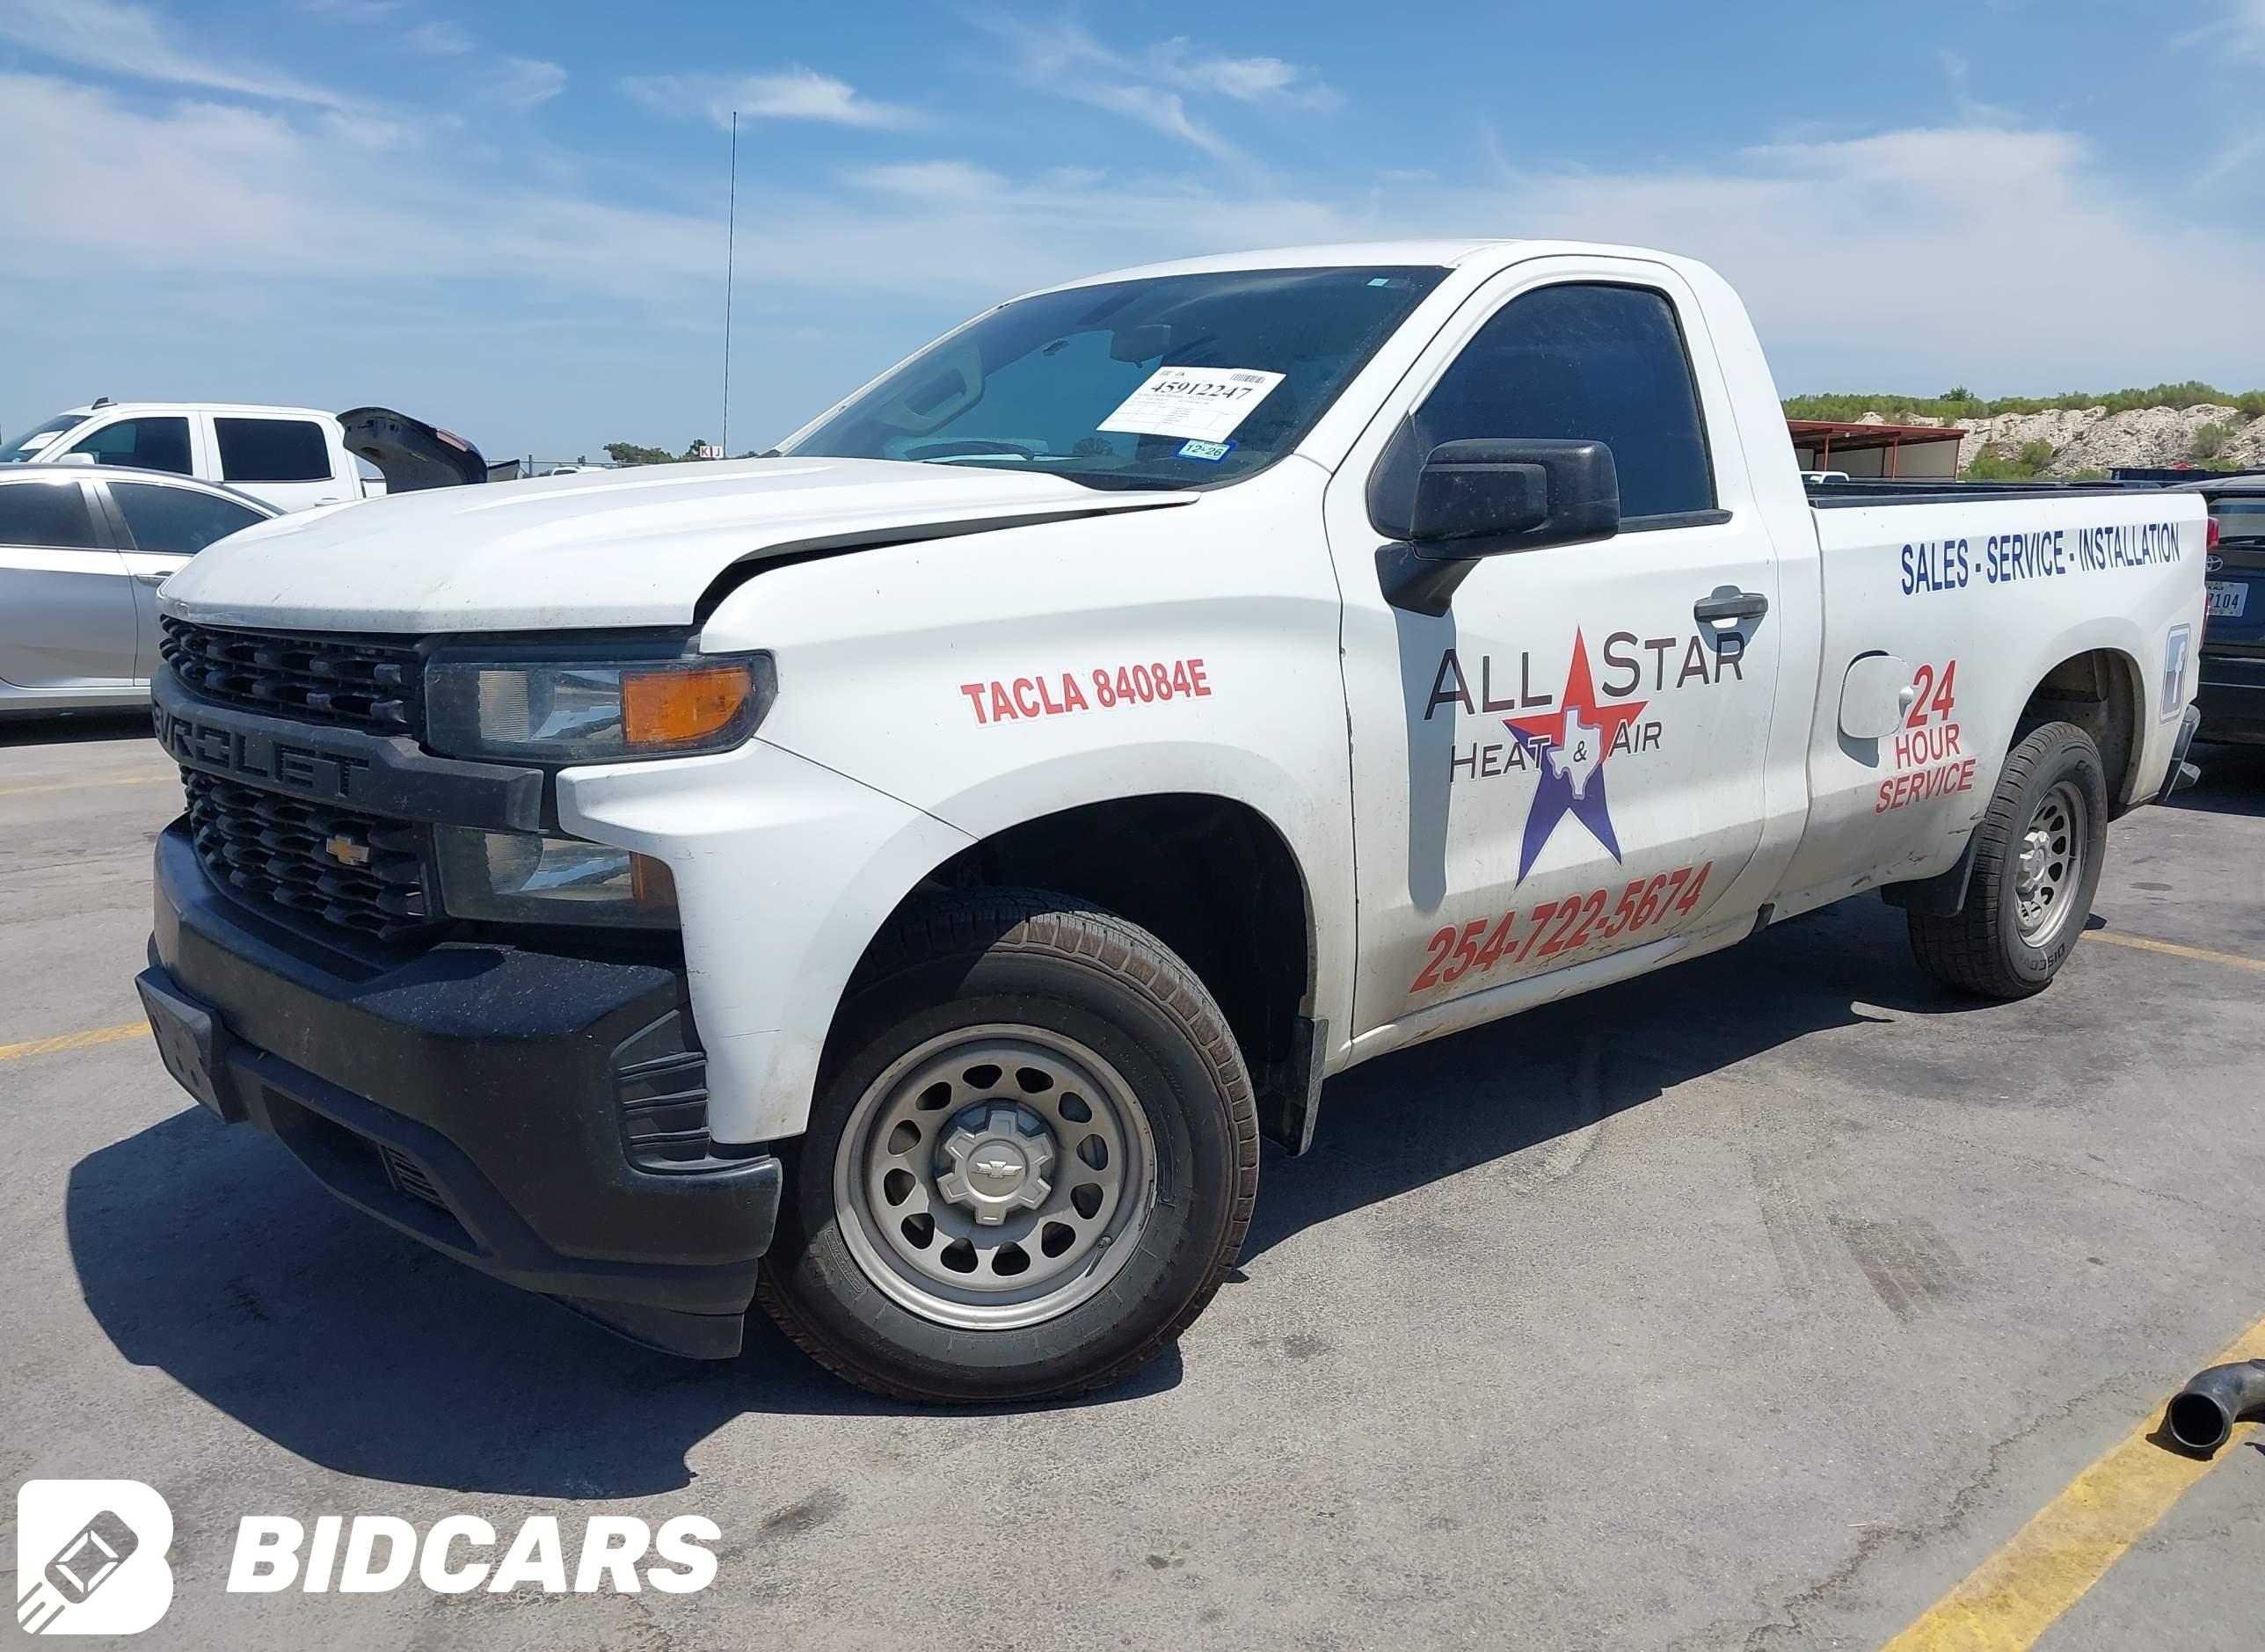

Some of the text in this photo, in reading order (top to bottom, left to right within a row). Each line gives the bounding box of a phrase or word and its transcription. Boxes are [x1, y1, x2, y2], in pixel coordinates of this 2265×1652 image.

[1151, 381, 1254, 400] 45912247
[1901, 539, 1969, 596] SALES
[1986, 530, 2065, 584] SERVICE
[2079, 522, 2181, 571] INSTALLATION
[960, 659, 1213, 724] TACLA 84084E
[1424, 631, 1746, 721] ALL STAR
[1905, 659, 1956, 729] 24
[1449, 721, 1663, 782] HEAT & AIR
[1895, 724, 1961, 768] HOUR
[1875, 758, 1977, 815] SERVICE
[1409, 860, 1714, 993] 254-722-5674
